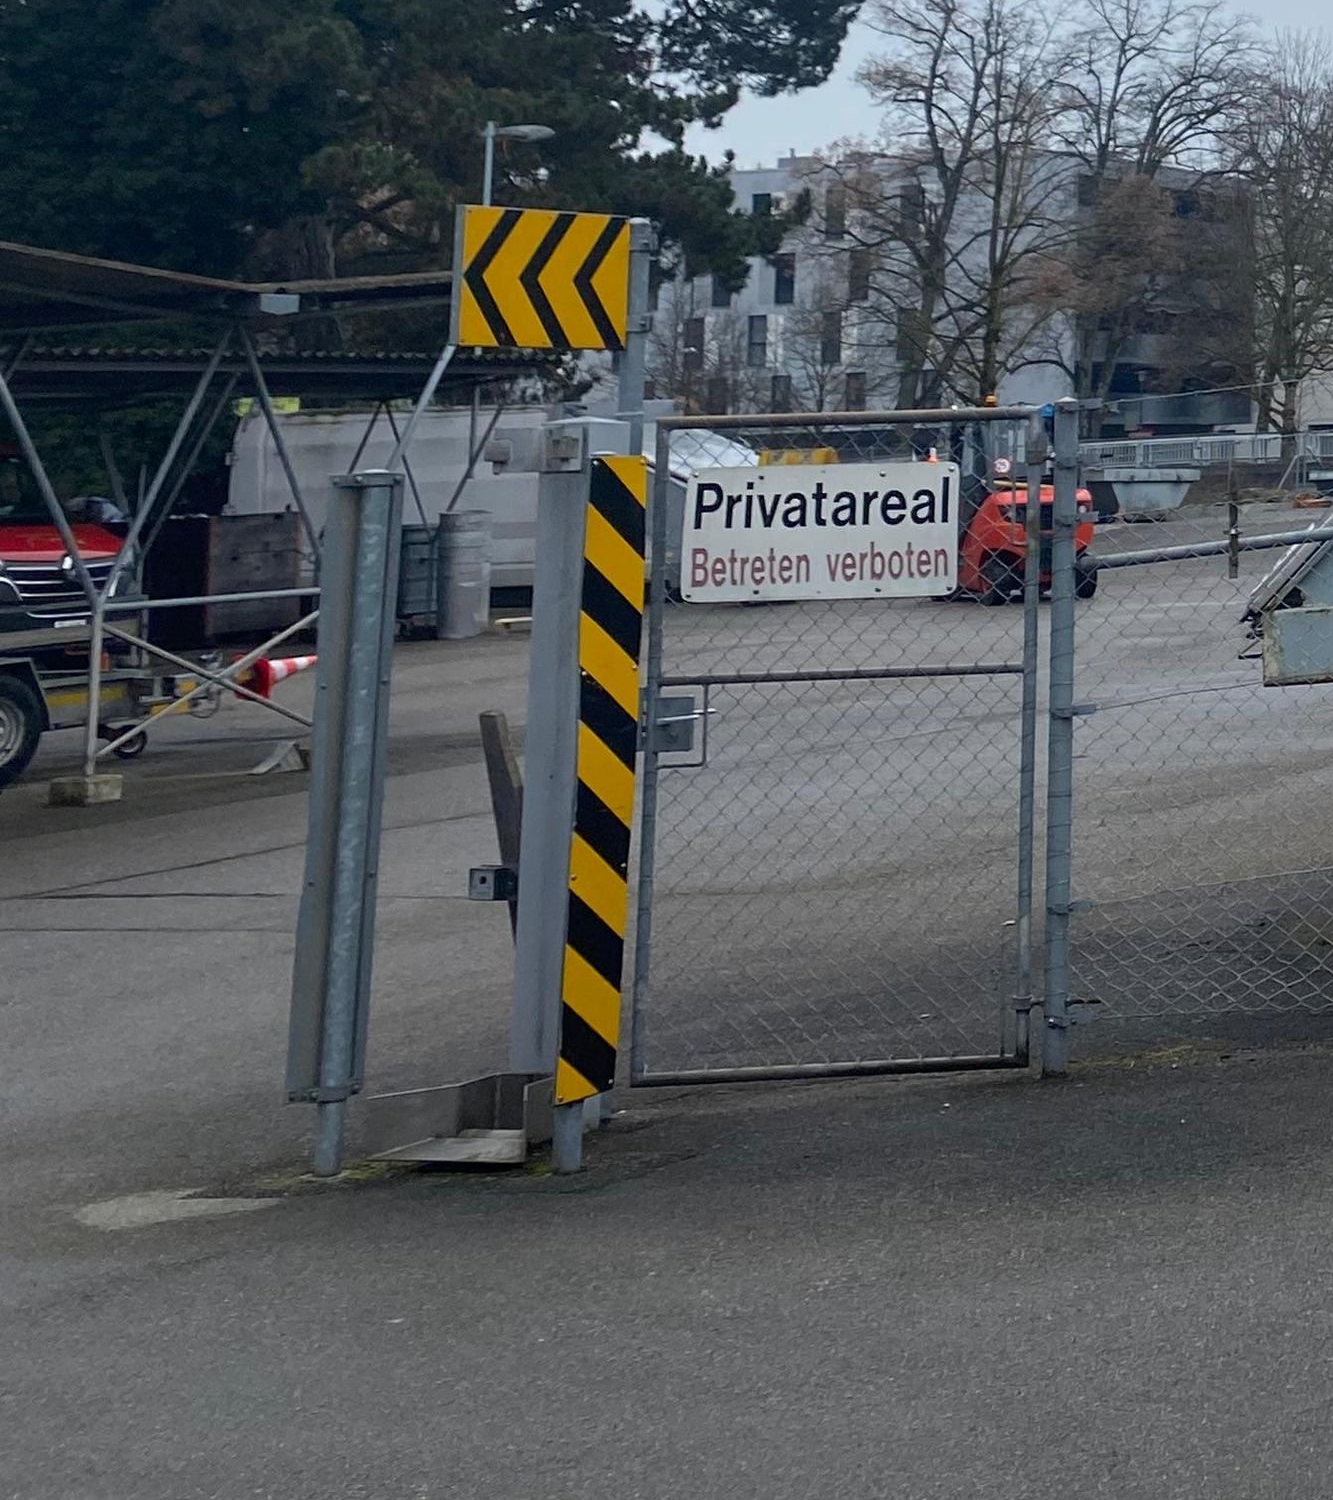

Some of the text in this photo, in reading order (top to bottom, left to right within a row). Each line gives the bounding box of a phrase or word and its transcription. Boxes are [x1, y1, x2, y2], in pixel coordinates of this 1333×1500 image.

[693, 475, 950, 529] Privatareal
[691, 541, 949, 588] Betreten verboten
